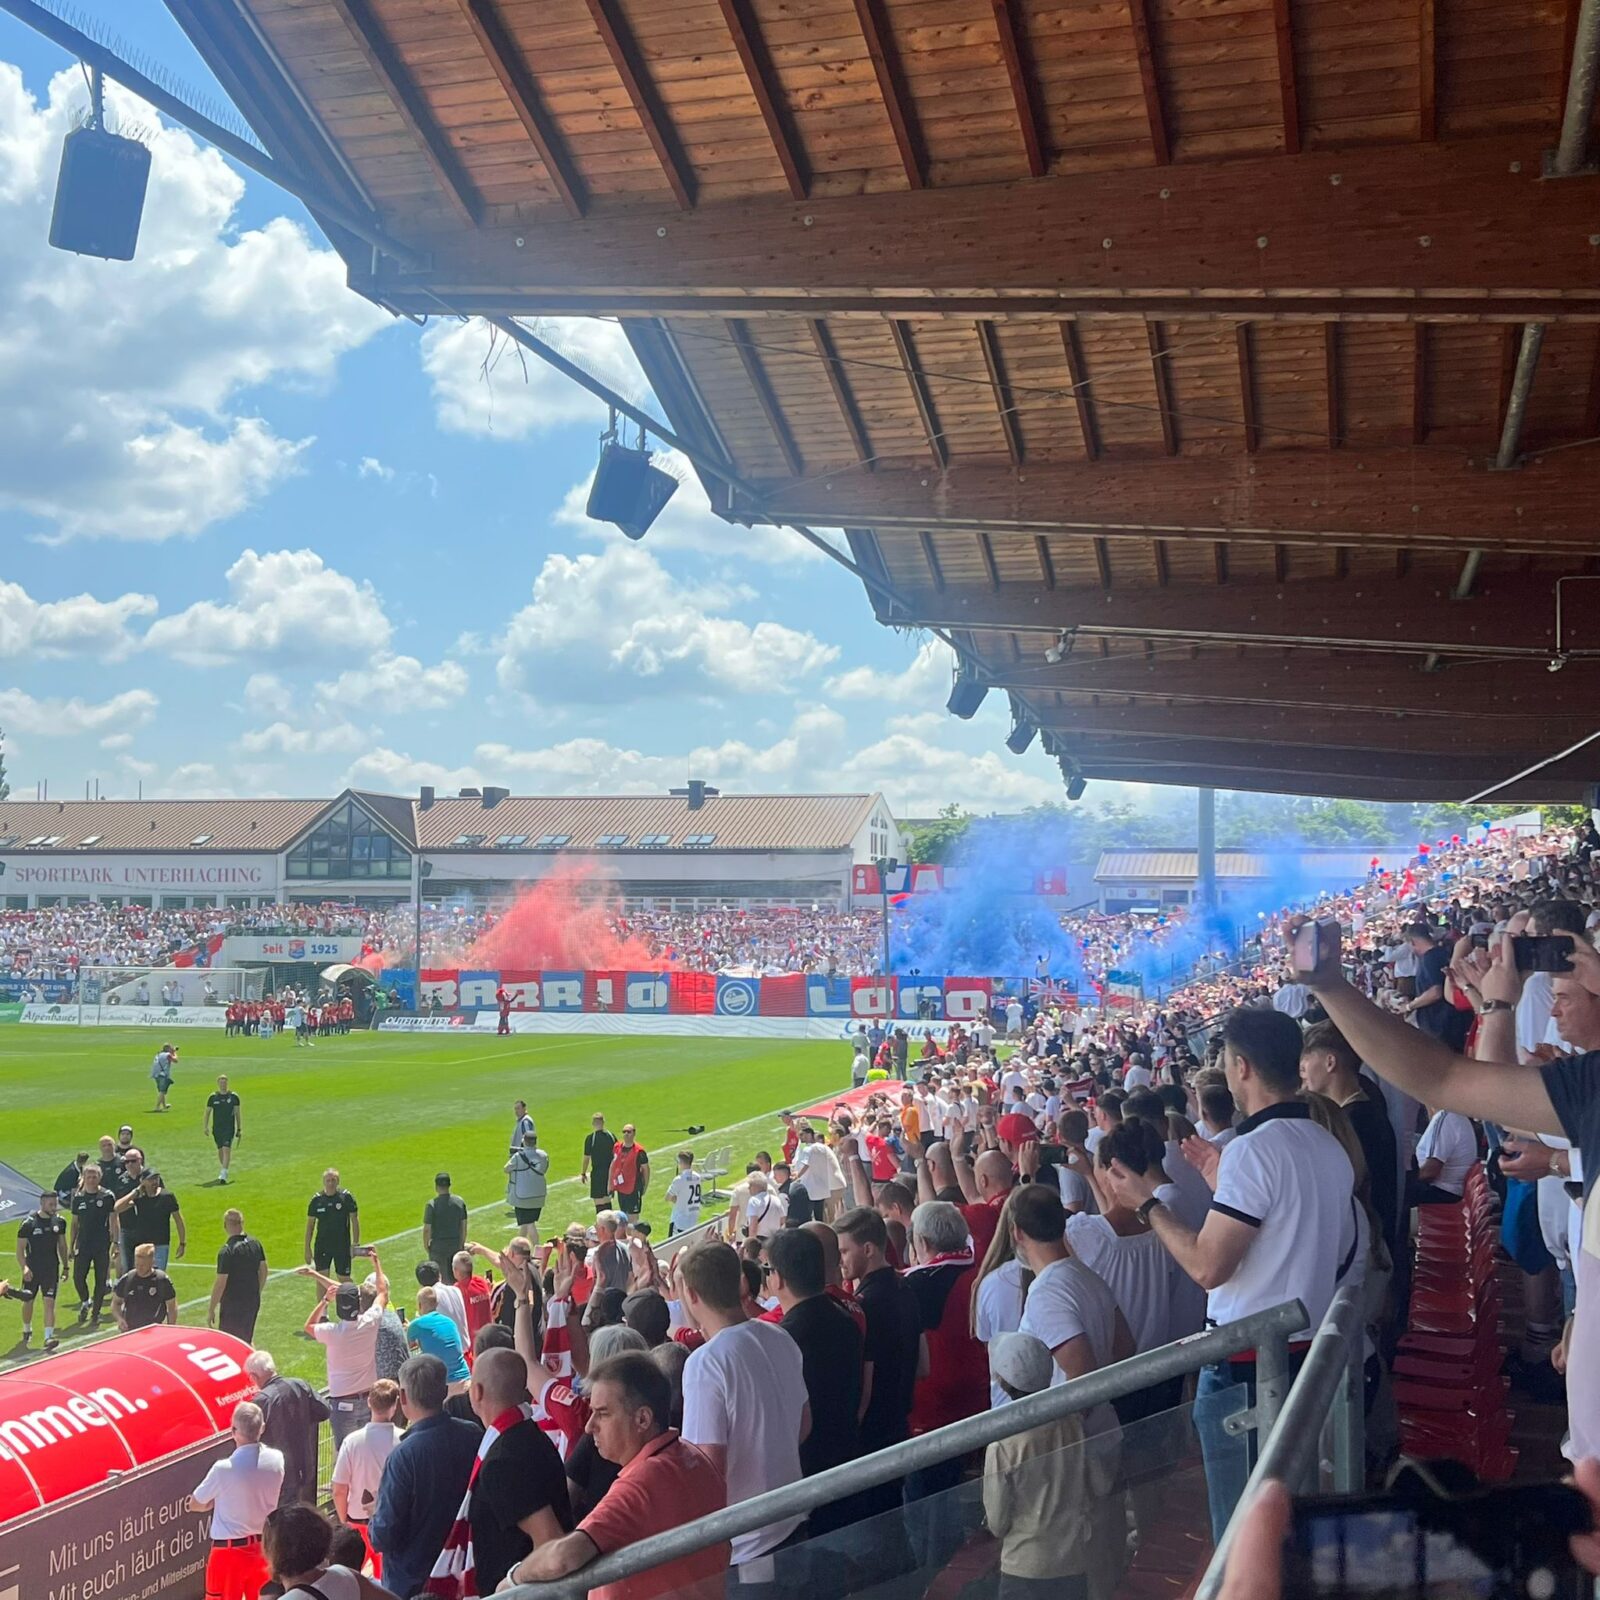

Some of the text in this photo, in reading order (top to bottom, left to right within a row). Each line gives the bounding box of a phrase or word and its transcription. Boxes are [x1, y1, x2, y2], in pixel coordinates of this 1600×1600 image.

[15, 867, 262, 883] SPORTPARK UNTERHACHING
[262, 943, 338, 954] Seit 1925
[420, 979, 988, 1018] BARRIO LOCO
[23, 1011, 77, 1022] Alpenbauer
[140, 1013, 194, 1025] Alpenbauer
[688, 1184, 701, 1204] 29
[50, 1494, 192, 1576] Mit uns läuft eure
[49, 1588, 76, 1600] Mit
[82, 1560, 125, 1599] euch
[131, 1540, 165, 1577] läuft
[170, 1529, 194, 1556] die
[141, 1556, 205, 1598] und Mittelstand
